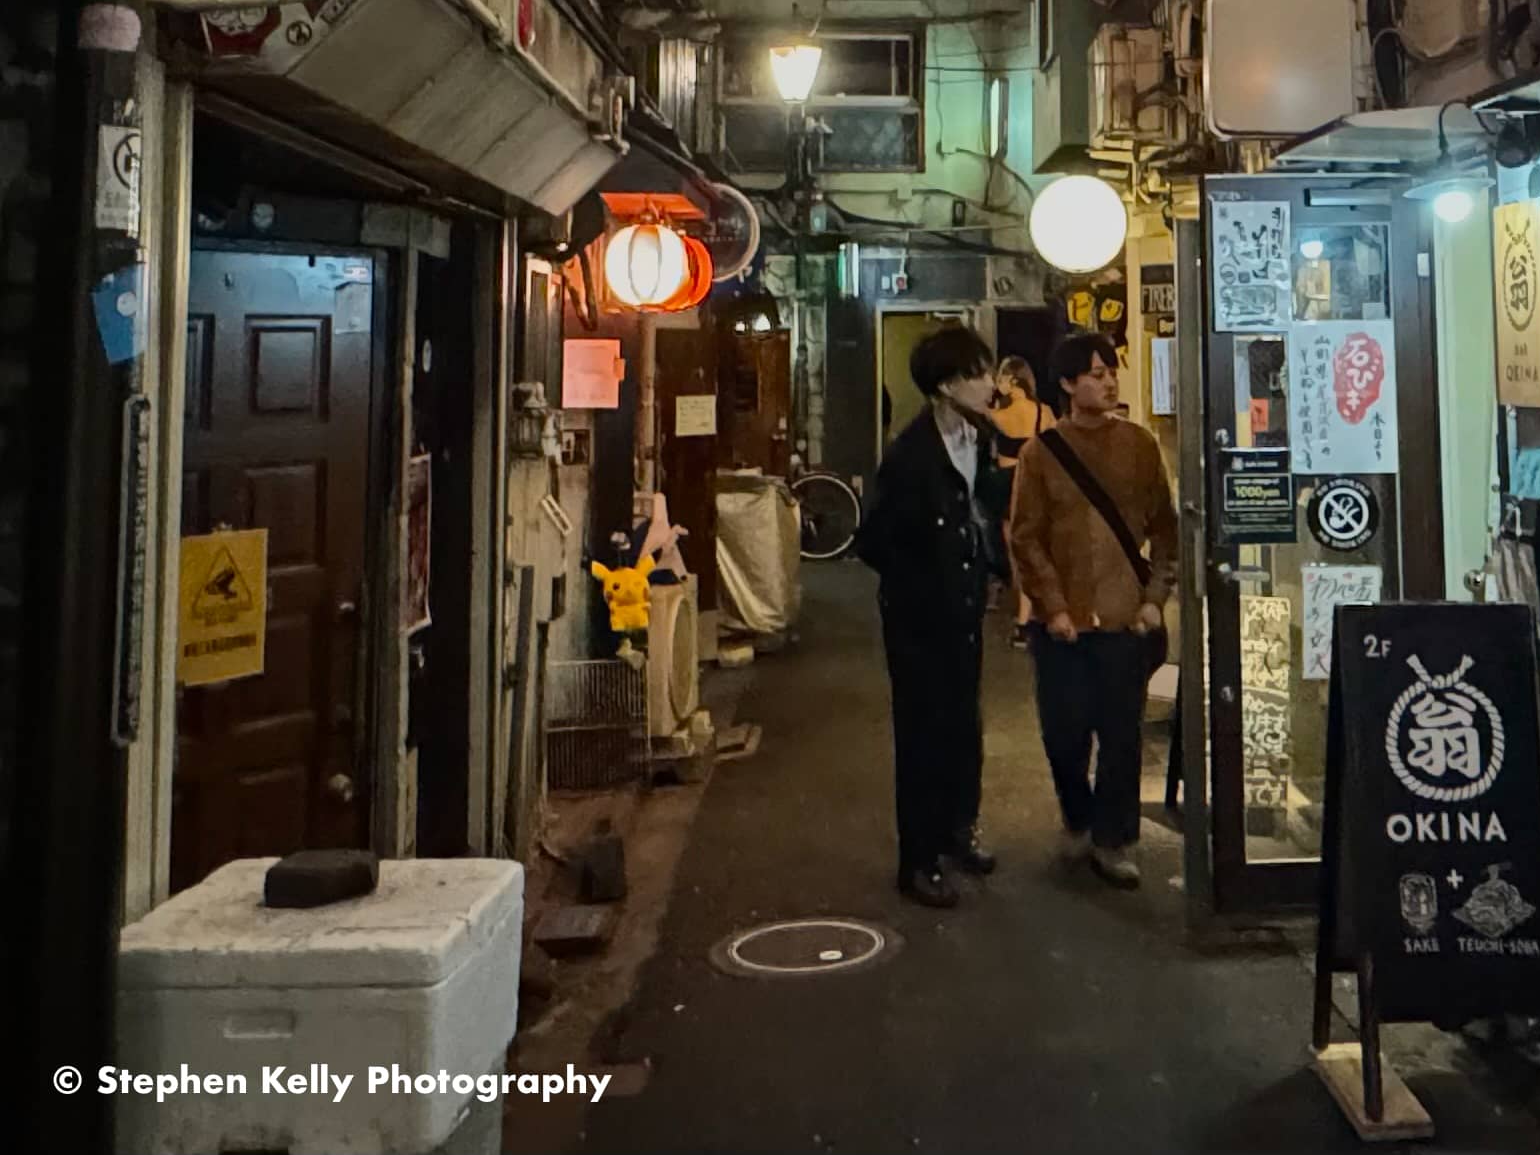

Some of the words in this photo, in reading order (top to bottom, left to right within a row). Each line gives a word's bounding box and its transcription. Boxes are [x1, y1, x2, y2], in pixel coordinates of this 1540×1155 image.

[1364, 634, 1392, 658] 2F
[1407, 692, 1481, 779] 翁
[1386, 812, 1507, 843] OKINA
